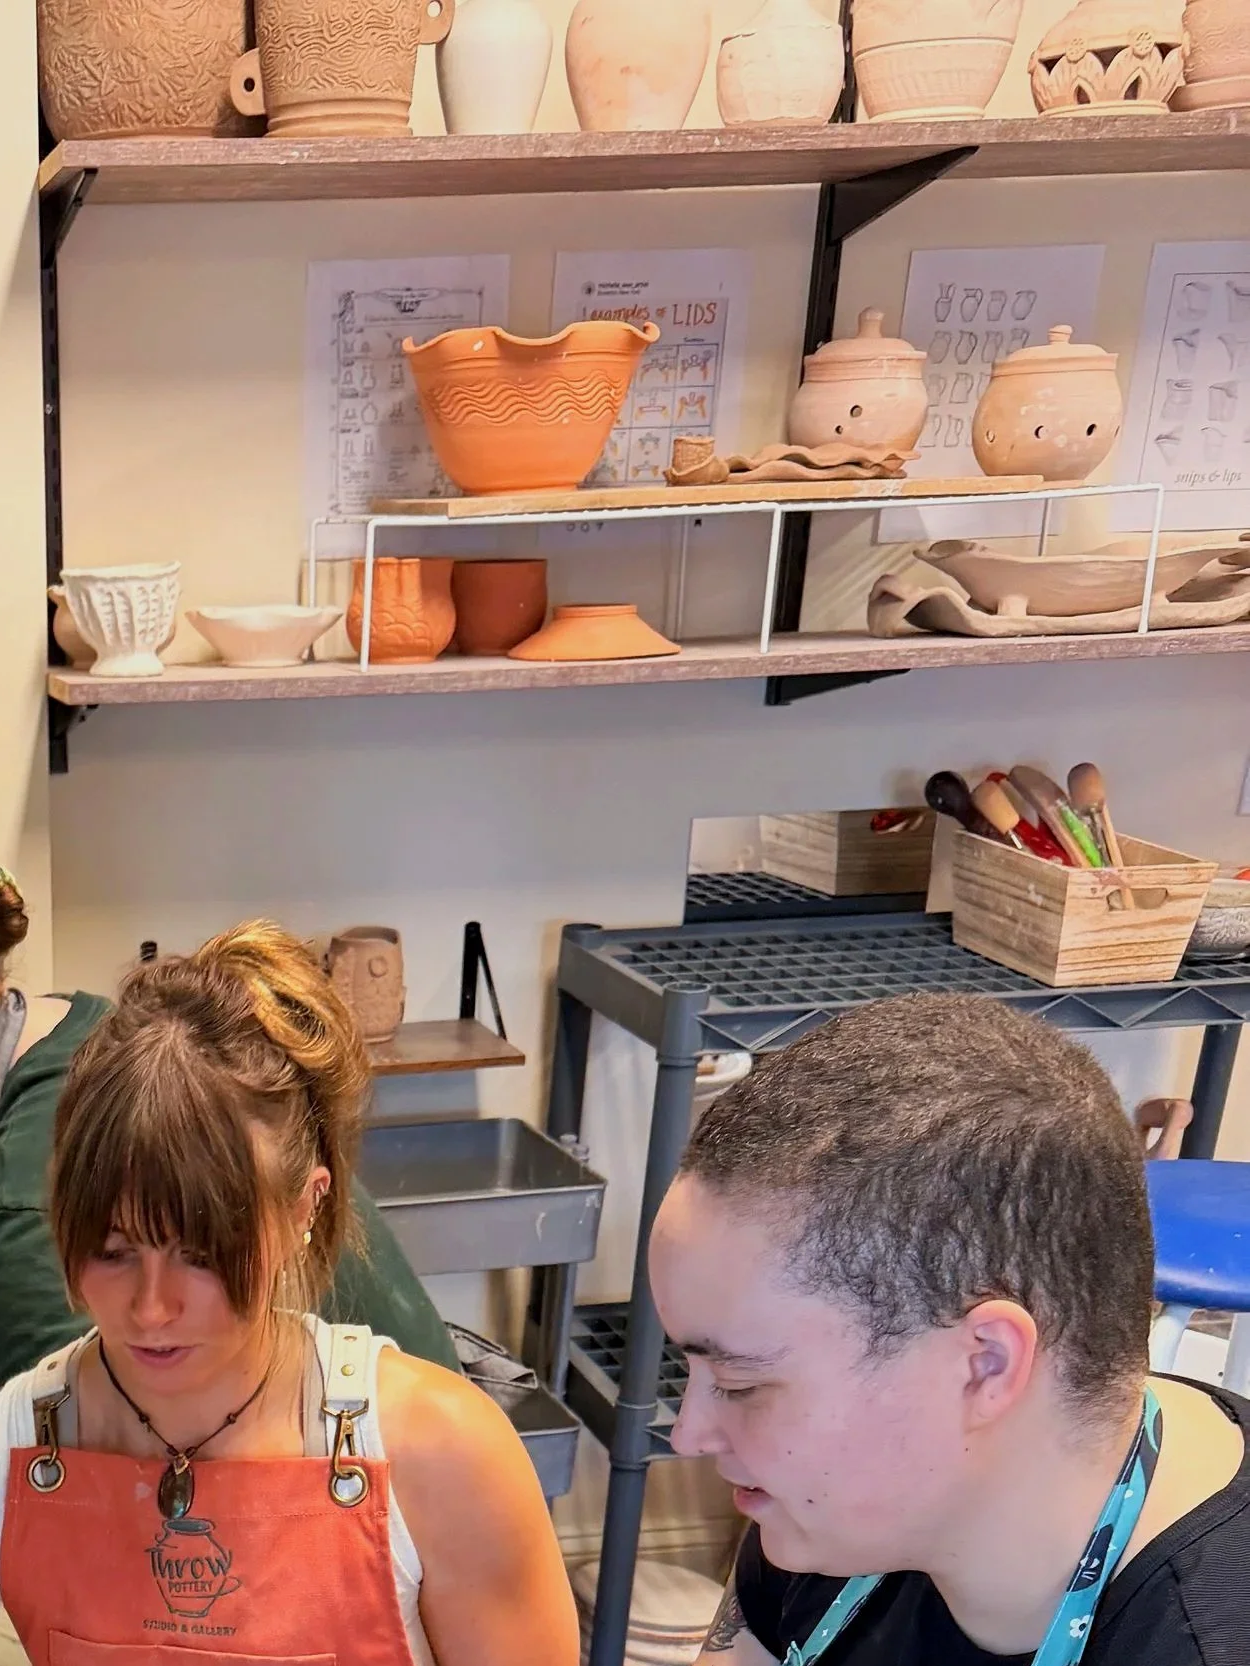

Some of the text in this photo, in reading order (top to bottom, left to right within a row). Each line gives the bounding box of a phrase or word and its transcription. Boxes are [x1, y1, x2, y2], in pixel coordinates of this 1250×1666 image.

[673, 302, 718, 327] LIDS
[1174, 468, 1243, 487] snips & lips
[144, 1546, 233, 1580] Throw
[168, 1580, 213, 1593] POTTERY
[143, 1619, 237, 1637] STUDIO & GALLERY
